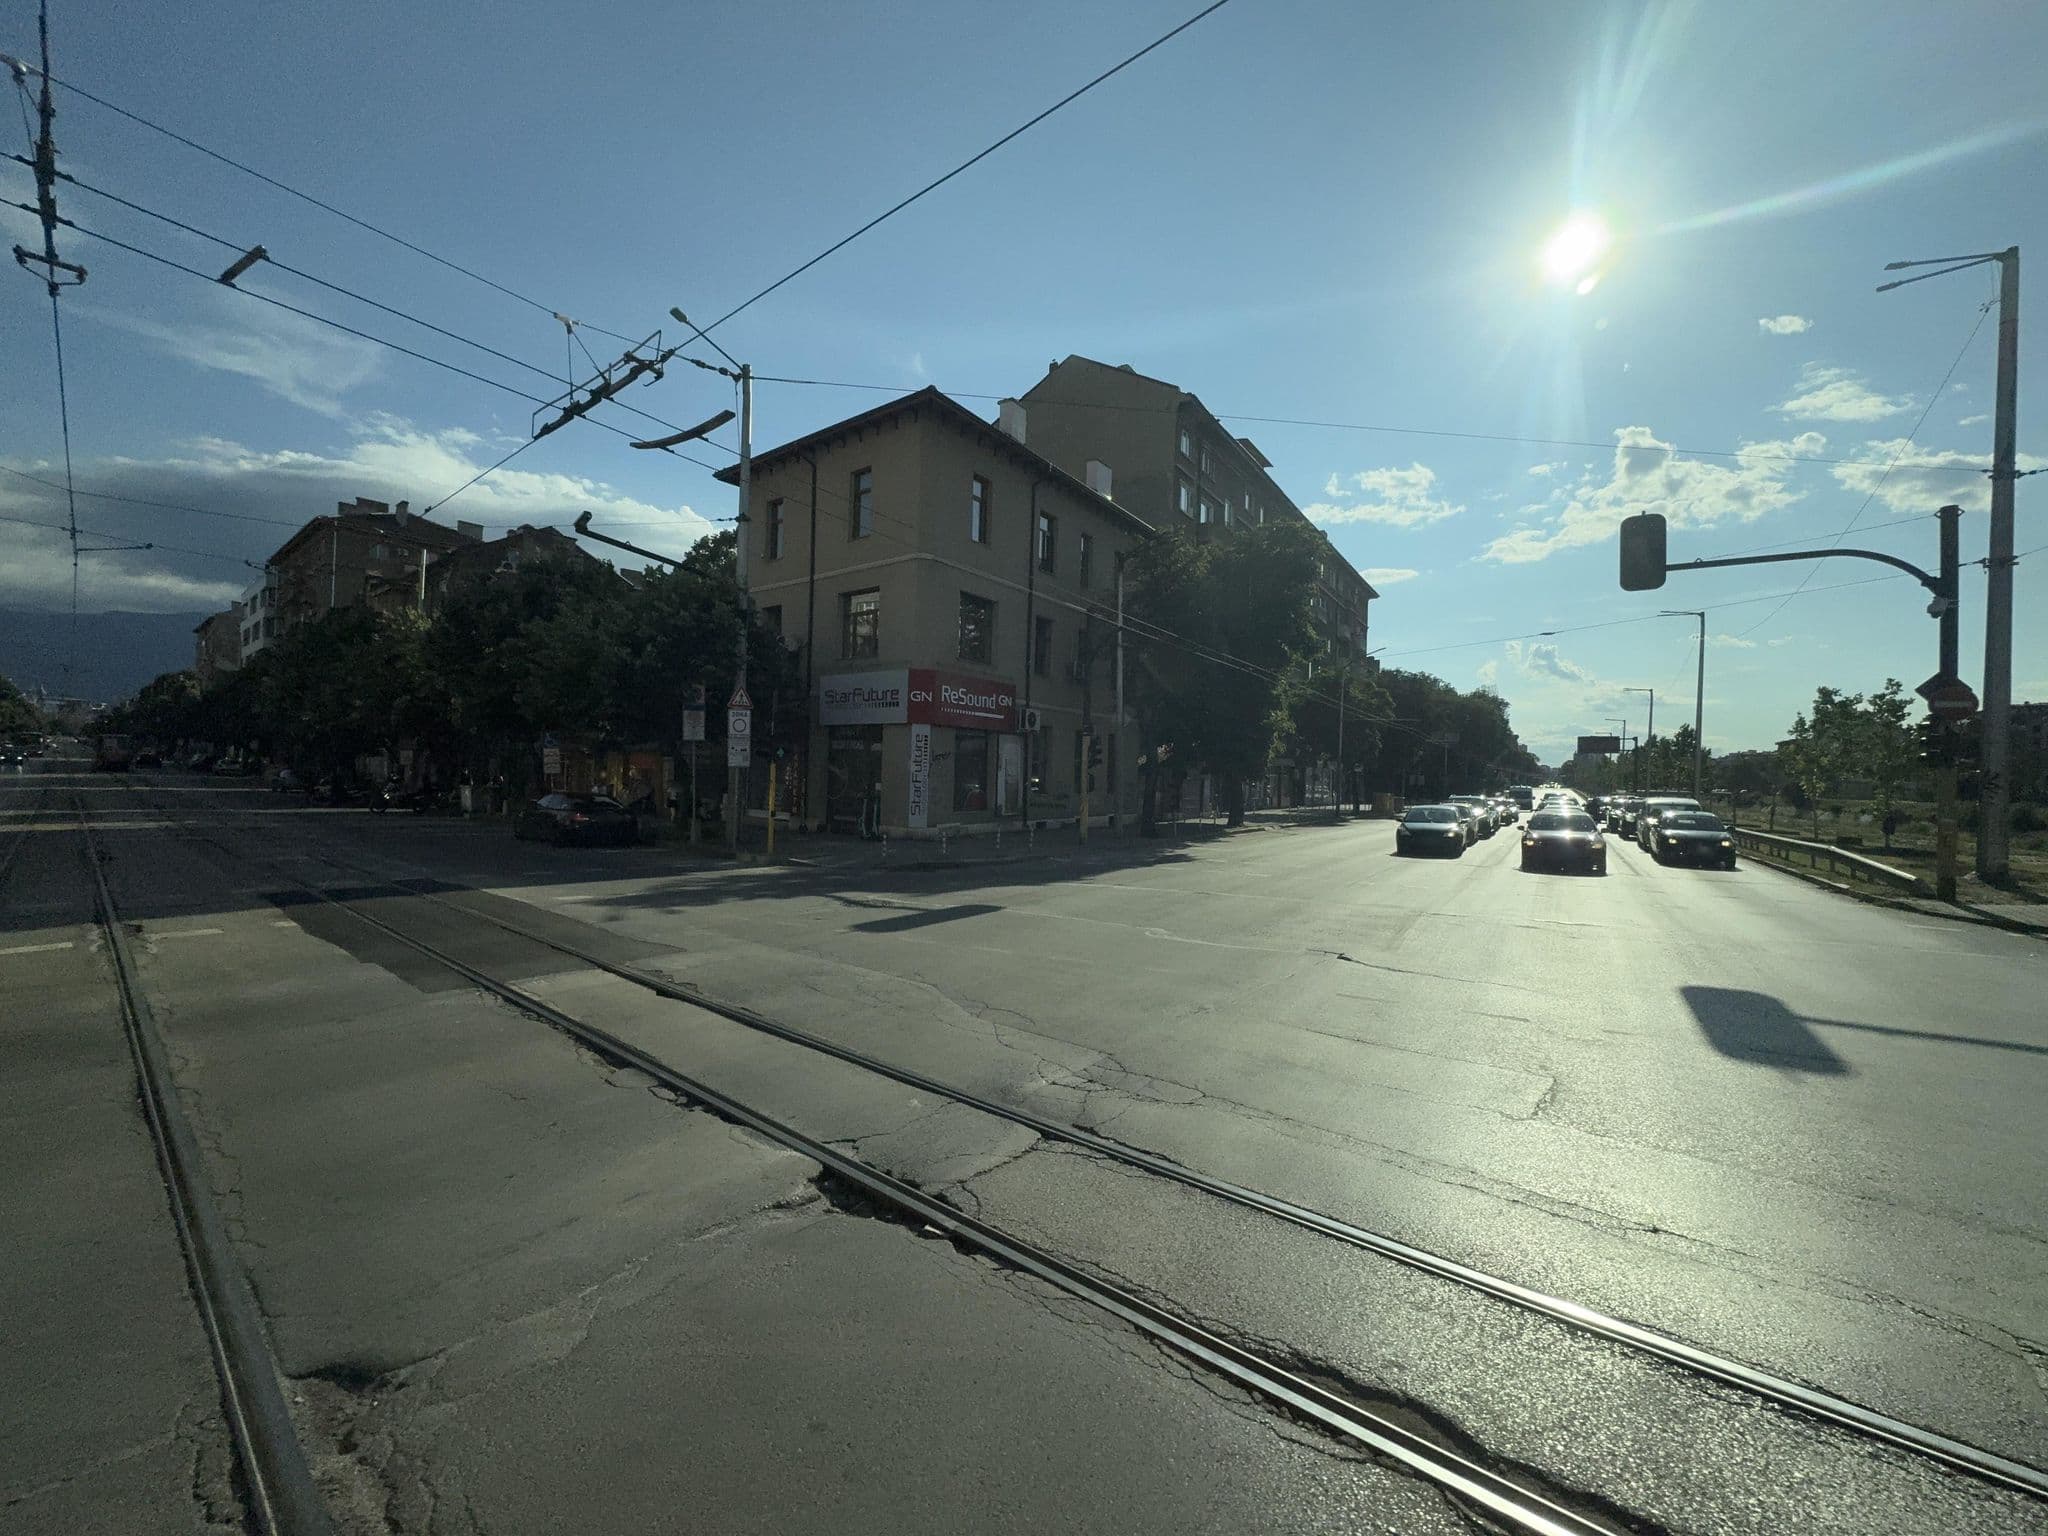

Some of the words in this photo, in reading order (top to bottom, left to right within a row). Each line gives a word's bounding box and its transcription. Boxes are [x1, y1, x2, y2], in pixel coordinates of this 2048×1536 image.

[824, 688, 899, 704] StarFuture
[911, 691, 932, 702] GN
[941, 685, 996, 709] ReSound
[998, 695, 1012, 706] GN
[911, 734, 924, 816] StarFuture
